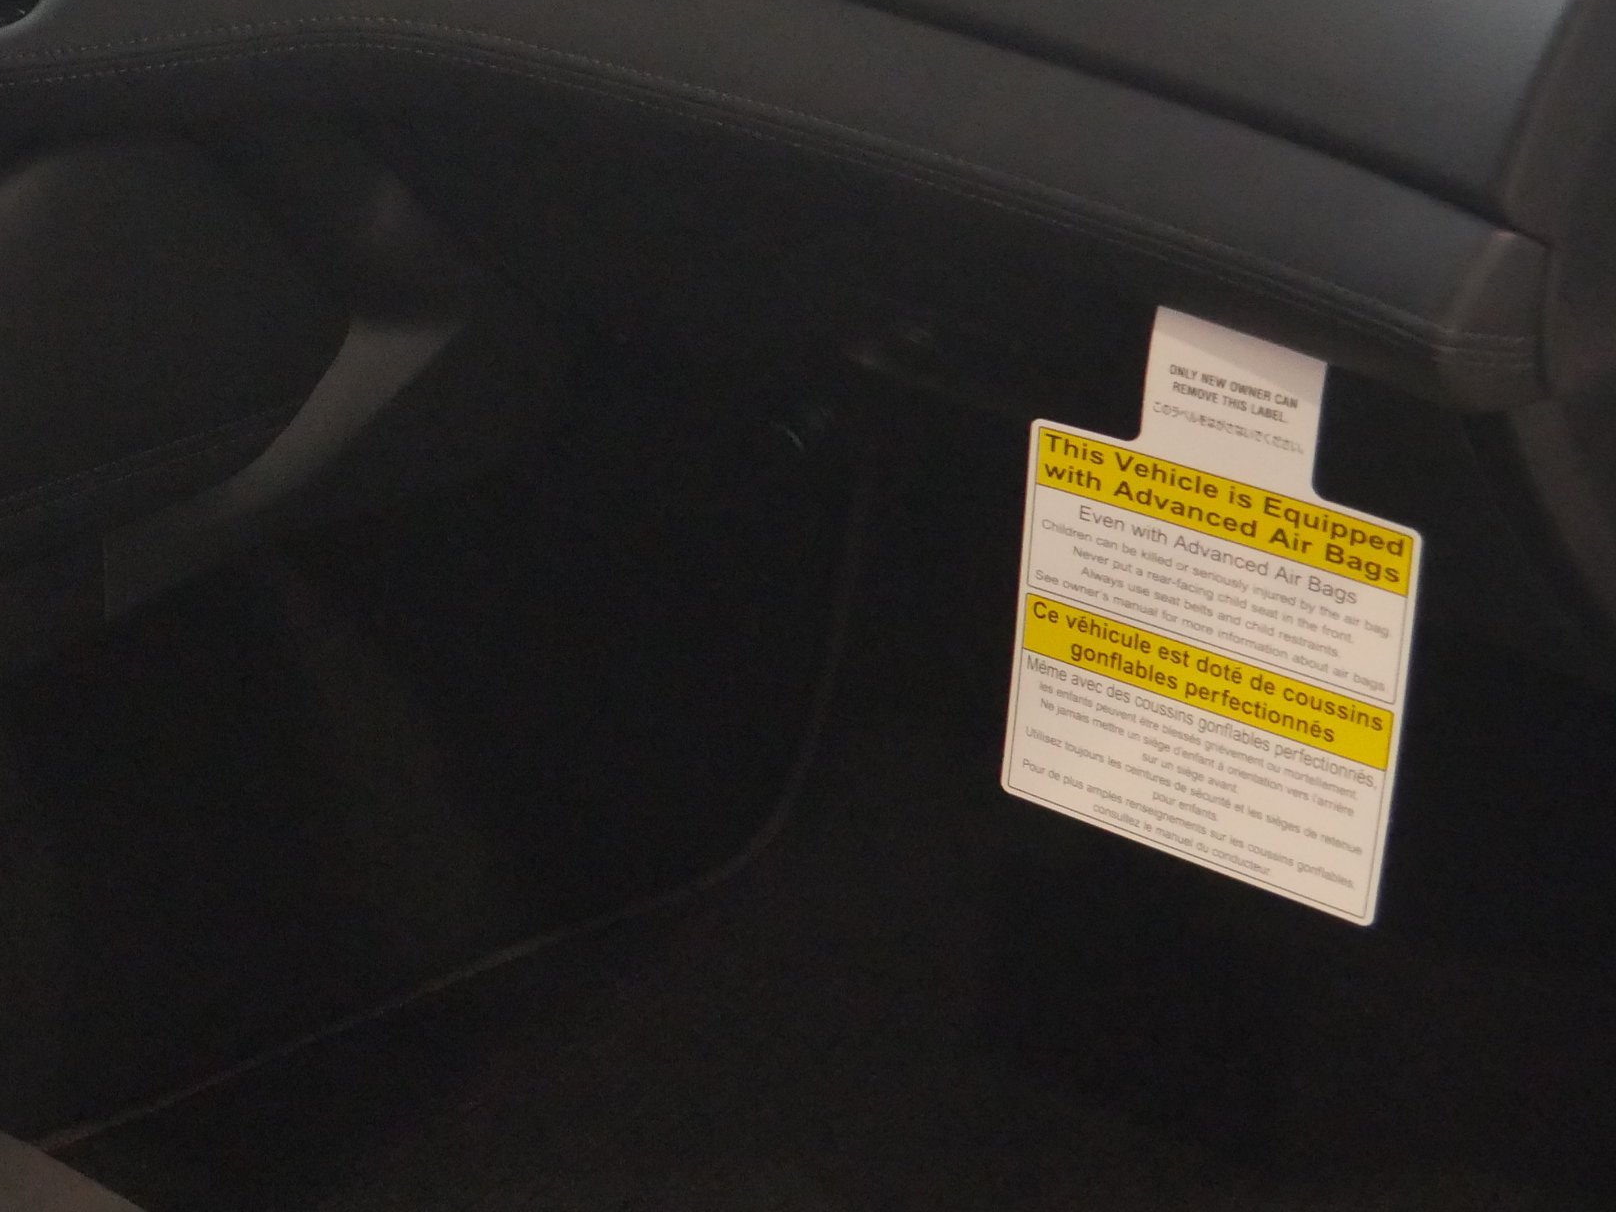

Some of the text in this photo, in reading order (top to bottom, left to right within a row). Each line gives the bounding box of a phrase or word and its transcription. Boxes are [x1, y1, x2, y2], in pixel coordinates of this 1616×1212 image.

[1168, 363, 1298, 410] ONLY NEW OWNER CAN
[1172, 381, 1219, 404] REMOVE
[1221, 395, 1247, 411] THIS
[1043, 459, 1401, 587] with Advanced Air Bags
[1044, 432, 1405, 558] This Vehicle is Equipped
[1041, 518, 1092, 542] Children
[1095, 536, 1118, 551] can
[1121, 543, 1137, 556] be
[1140, 549, 1173, 568] killed
[1176, 561, 1188, 572] or
[1191, 566, 1248, 593] seriously
[1251, 584, 1296, 608] injured
[1299, 599, 1316, 615] by
[1318, 605, 1341, 621] the
[1343, 613, 1360, 627] air
[1072, 546, 1109, 565] Never
[1112, 559, 1132, 574] put
[1135, 566, 1143, 576] a
[1146, 569, 1213, 600] rear-facing
[1216, 591, 1247, 609] child
[1250, 602, 1278, 619] seat
[1282, 612, 1294, 624] in
[1296, 616, 1318, 632] the
[1078, 504, 1359, 607] Even with Advanced Air Bags
[1080, 566, 1124, 590] Always
[1127, 582, 1150, 596] use
[1153, 589, 1180, 606] seat
[1183, 599, 1214, 617] belts
[1216, 610, 1241, 626] and
[1244, 619, 1275, 637] child
[1032, 600, 1385, 731] Ce véhicule est doté de coussins
[1035, 569, 1059, 585] See
[1062, 578, 1109, 601] owner's
[1112, 594, 1158, 617] manual
[1161, 609, 1178, 623] for
[1181, 617, 1214, 635] more
[1217, 628, 1288, 659] information
[1291, 652, 1329, 673] about
[1332, 665, 1349, 680] air
[1026, 655, 1067, 681] Même
[1070, 672, 1103, 693] avec
[1105, 682, 1131, 703] des
[1134, 693, 1194, 725] coussins
[1197, 715, 1270, 754] gonflables
[1039, 681, 1053, 694] les
[1056, 687, 1093, 707] enfants
[1095, 701, 1137, 724] peuvent
[1139, 716, 1159, 731] être
[1162, 724, 1201, 746] blessés
[1203, 740, 1264, 769] grièvement
[1266, 762, 1281, 773] ou
[1070, 640, 1336, 745] gonflables perfectionnés
[1024, 726, 1062, 748] Utilisez
[1064, 741, 1105, 764] toujours
[1107, 757, 1122, 770] les
[1124, 764, 1171, 787] ceintures
[1174, 780, 1187, 793] de
[1189, 786, 1232, 809] sécurité
[1234, 802, 1244, 814] et
[1247, 806, 1263, 821] les
[1265, 813, 1301, 836] sièges
[1303, 827, 1318, 840] de
[1040, 698, 1054, 712] Ne
[1055, 704, 1090, 725] jamais
[1092, 717, 1124, 736] mettre
[1126, 730, 1140, 742] un
[1142, 735, 1170, 754] siège
[1217, 762, 1224, 772] à
[1226, 765, 1283, 792] orientation
[1286, 786, 1309, 801] vers
[1141, 752, 1158, 765] sur
[1160, 760, 1174, 771] un
[1176, 764, 1205, 784] siège
[1151, 791, 1176, 807] pour
[1022, 758, 1045, 776] Pour
[1047, 768, 1061, 781] de
[1062, 774, 1084, 792] plus
[1086, 784, 1123, 805] amples
[1124, 798, 1207, 836] renseignements
[1209, 829, 1226, 843] sur
[1229, 835, 1244, 849] les
[1247, 843, 1295, 867] coussins
[1092, 803, 1140, 828] consultez
[1143, 821, 1152, 833] le
[1154, 826, 1193, 847] manuel
[1196, 841, 1209, 854] du
